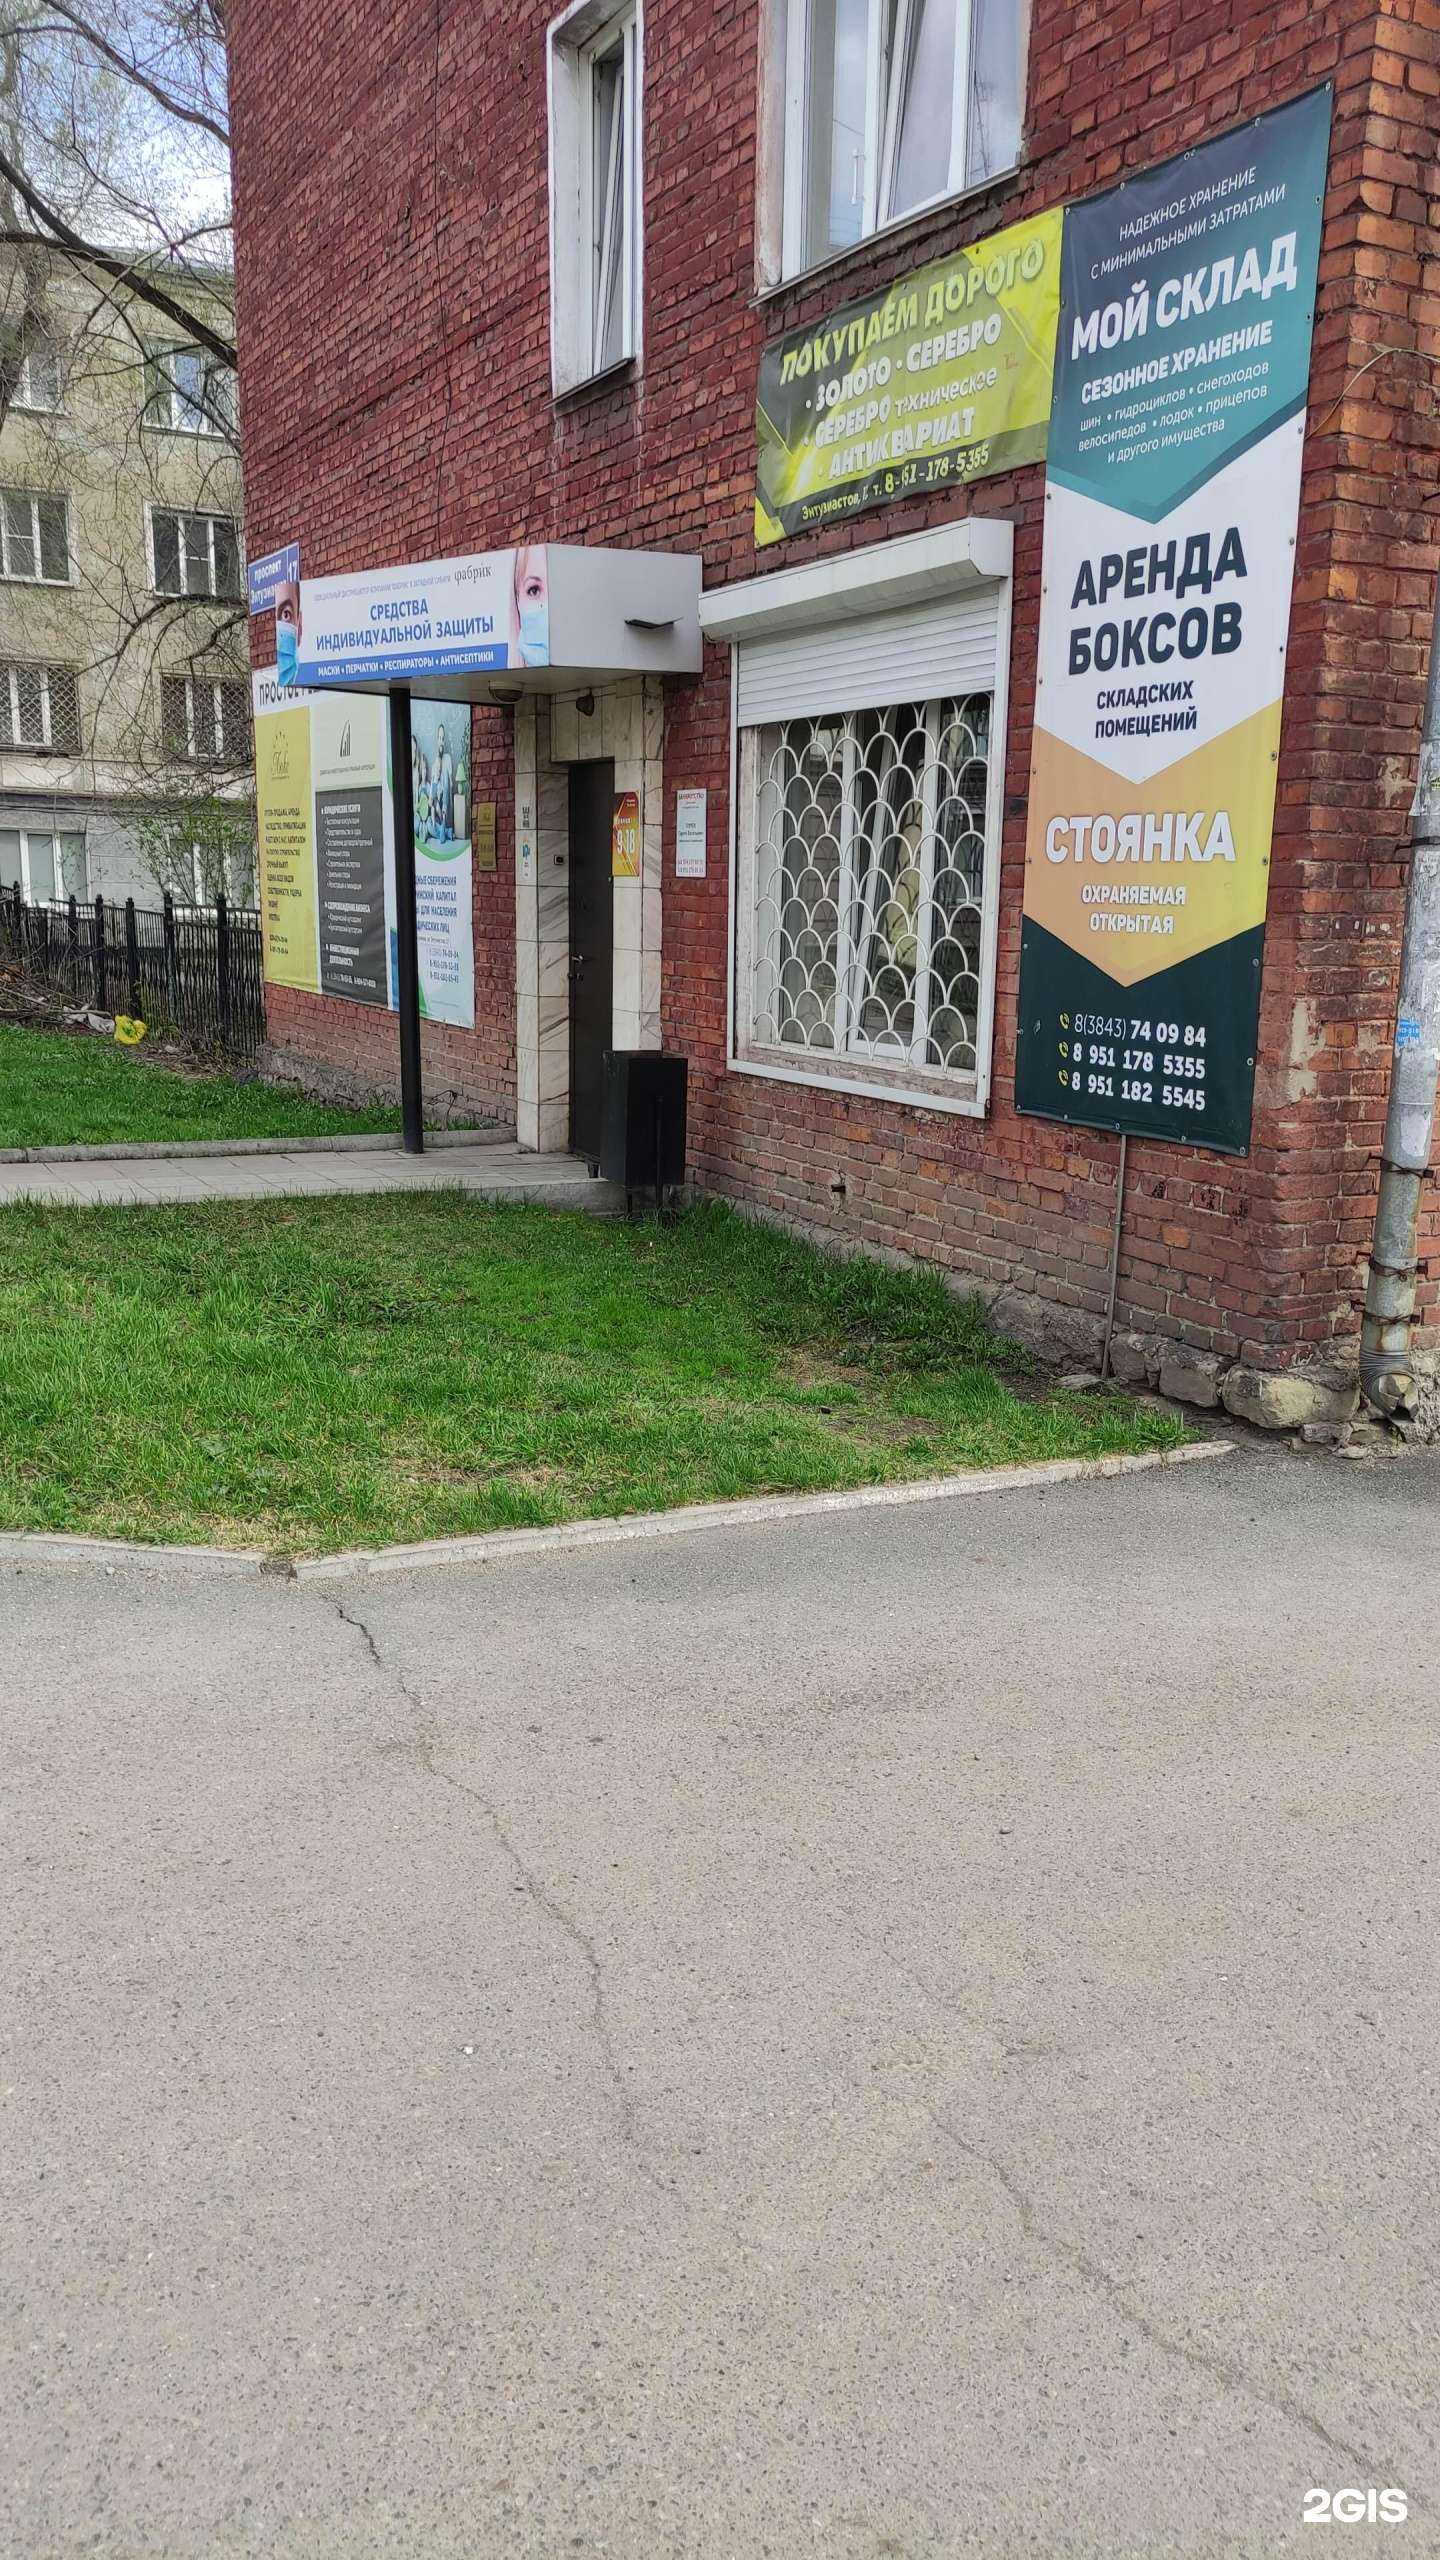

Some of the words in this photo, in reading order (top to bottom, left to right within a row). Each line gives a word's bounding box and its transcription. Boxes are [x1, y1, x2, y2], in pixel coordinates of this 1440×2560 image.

[1119, 200, 1187, 242] НАДЕЖНОЕ
[1189, 166, 1257, 209] ХРАНЕНИЕ
[1090, 263, 1099, 280] С
[1101, 219, 1207, 277] МИНИМАЛЬНЫМИ
[1209, 184, 1286, 231] ЗАТРАТАМИ
[780, 293, 918, 387] ПОКУПАЕМ
[925, 239, 1045, 329] ДОРОГО
[1071, 279, 1150, 361] МОЙ
[1155, 231, 1298, 328] СКЛАД
[816, 356, 891, 412] ЗОЛОТО
[907, 313, 1002, 373] СЕРЕБРО
[1081, 355, 1170, 405] СЕЗОННОЕ
[1170, 320, 1273, 376] ХРАНЕНИЕ
[815, 394, 891, 448] СЕРЕБРО
[895, 367, 997, 417] тхническое
[1078, 422, 1146, 452] велосипедов
[1160, 406, 1195, 428] лодок
[1205, 385, 1268, 415] прицепов
[1080, 415, 1101, 432] шин
[1114, 388, 1186, 421] гидроциклов
[1197, 361, 1270, 395] снегоходов
[829, 407, 976, 481] АНТИКВАРИАТ
[1107, 452, 1115, 464] и
[1116, 440, 1159, 464] другого
[1161, 418, 1225, 449] имущества
[885, 444, 989, 495] 8-51-178-5355
[454, 562, 492, 585] фабрик
[1070, 526, 1248, 610] АРЕНДА
[316, 619, 432, 652] ИНДИВИДУАЛЬНОЙ
[436, 615, 494, 639] ЗАЩИТЫ
[370, 598, 429, 622] СРЕДСТВА
[318, 665, 340, 677] МАСКИ
[345, 662, 379, 675] ПЕРЧАТКИ
[384, 657, 434, 671] РЕСПИРАТОРЫ
[440, 650, 494, 666] АНТИСЕПТИКИ
[1068, 601, 1242, 676] БОКСОВ
[1096, 680, 1195, 710] СКЛАДСКИХ
[1095, 705, 1198, 739] ПОМЕЩЕНИЙ
[1046, 811, 1236, 864] СТОЯНКА
[1082, 884, 1187, 905] ОХРАНЯЕМАЯ
[1090, 912, 1175, 934] ОТКРЫТАЯ
[1074, 1013, 1127, 1041] 8(3843)
[1130, 1019, 1152, 1041] 74
[1156, 1022, 1179, 1045] 09
[1183, 1025, 1207, 1048] 84
[1073, 1042, 1083, 1063] 8
[1089, 1044, 1116, 1068] 951
[1123, 1049, 1154, 1073] 178
[1163, 1054, 1206, 1080] 5355
[1071, 1071, 1081, 1091] 8
[1088, 1074, 1114, 1097] 951
[1121, 1079, 1153, 1103] 182
[1162, 1085, 1206, 1111] 5545
